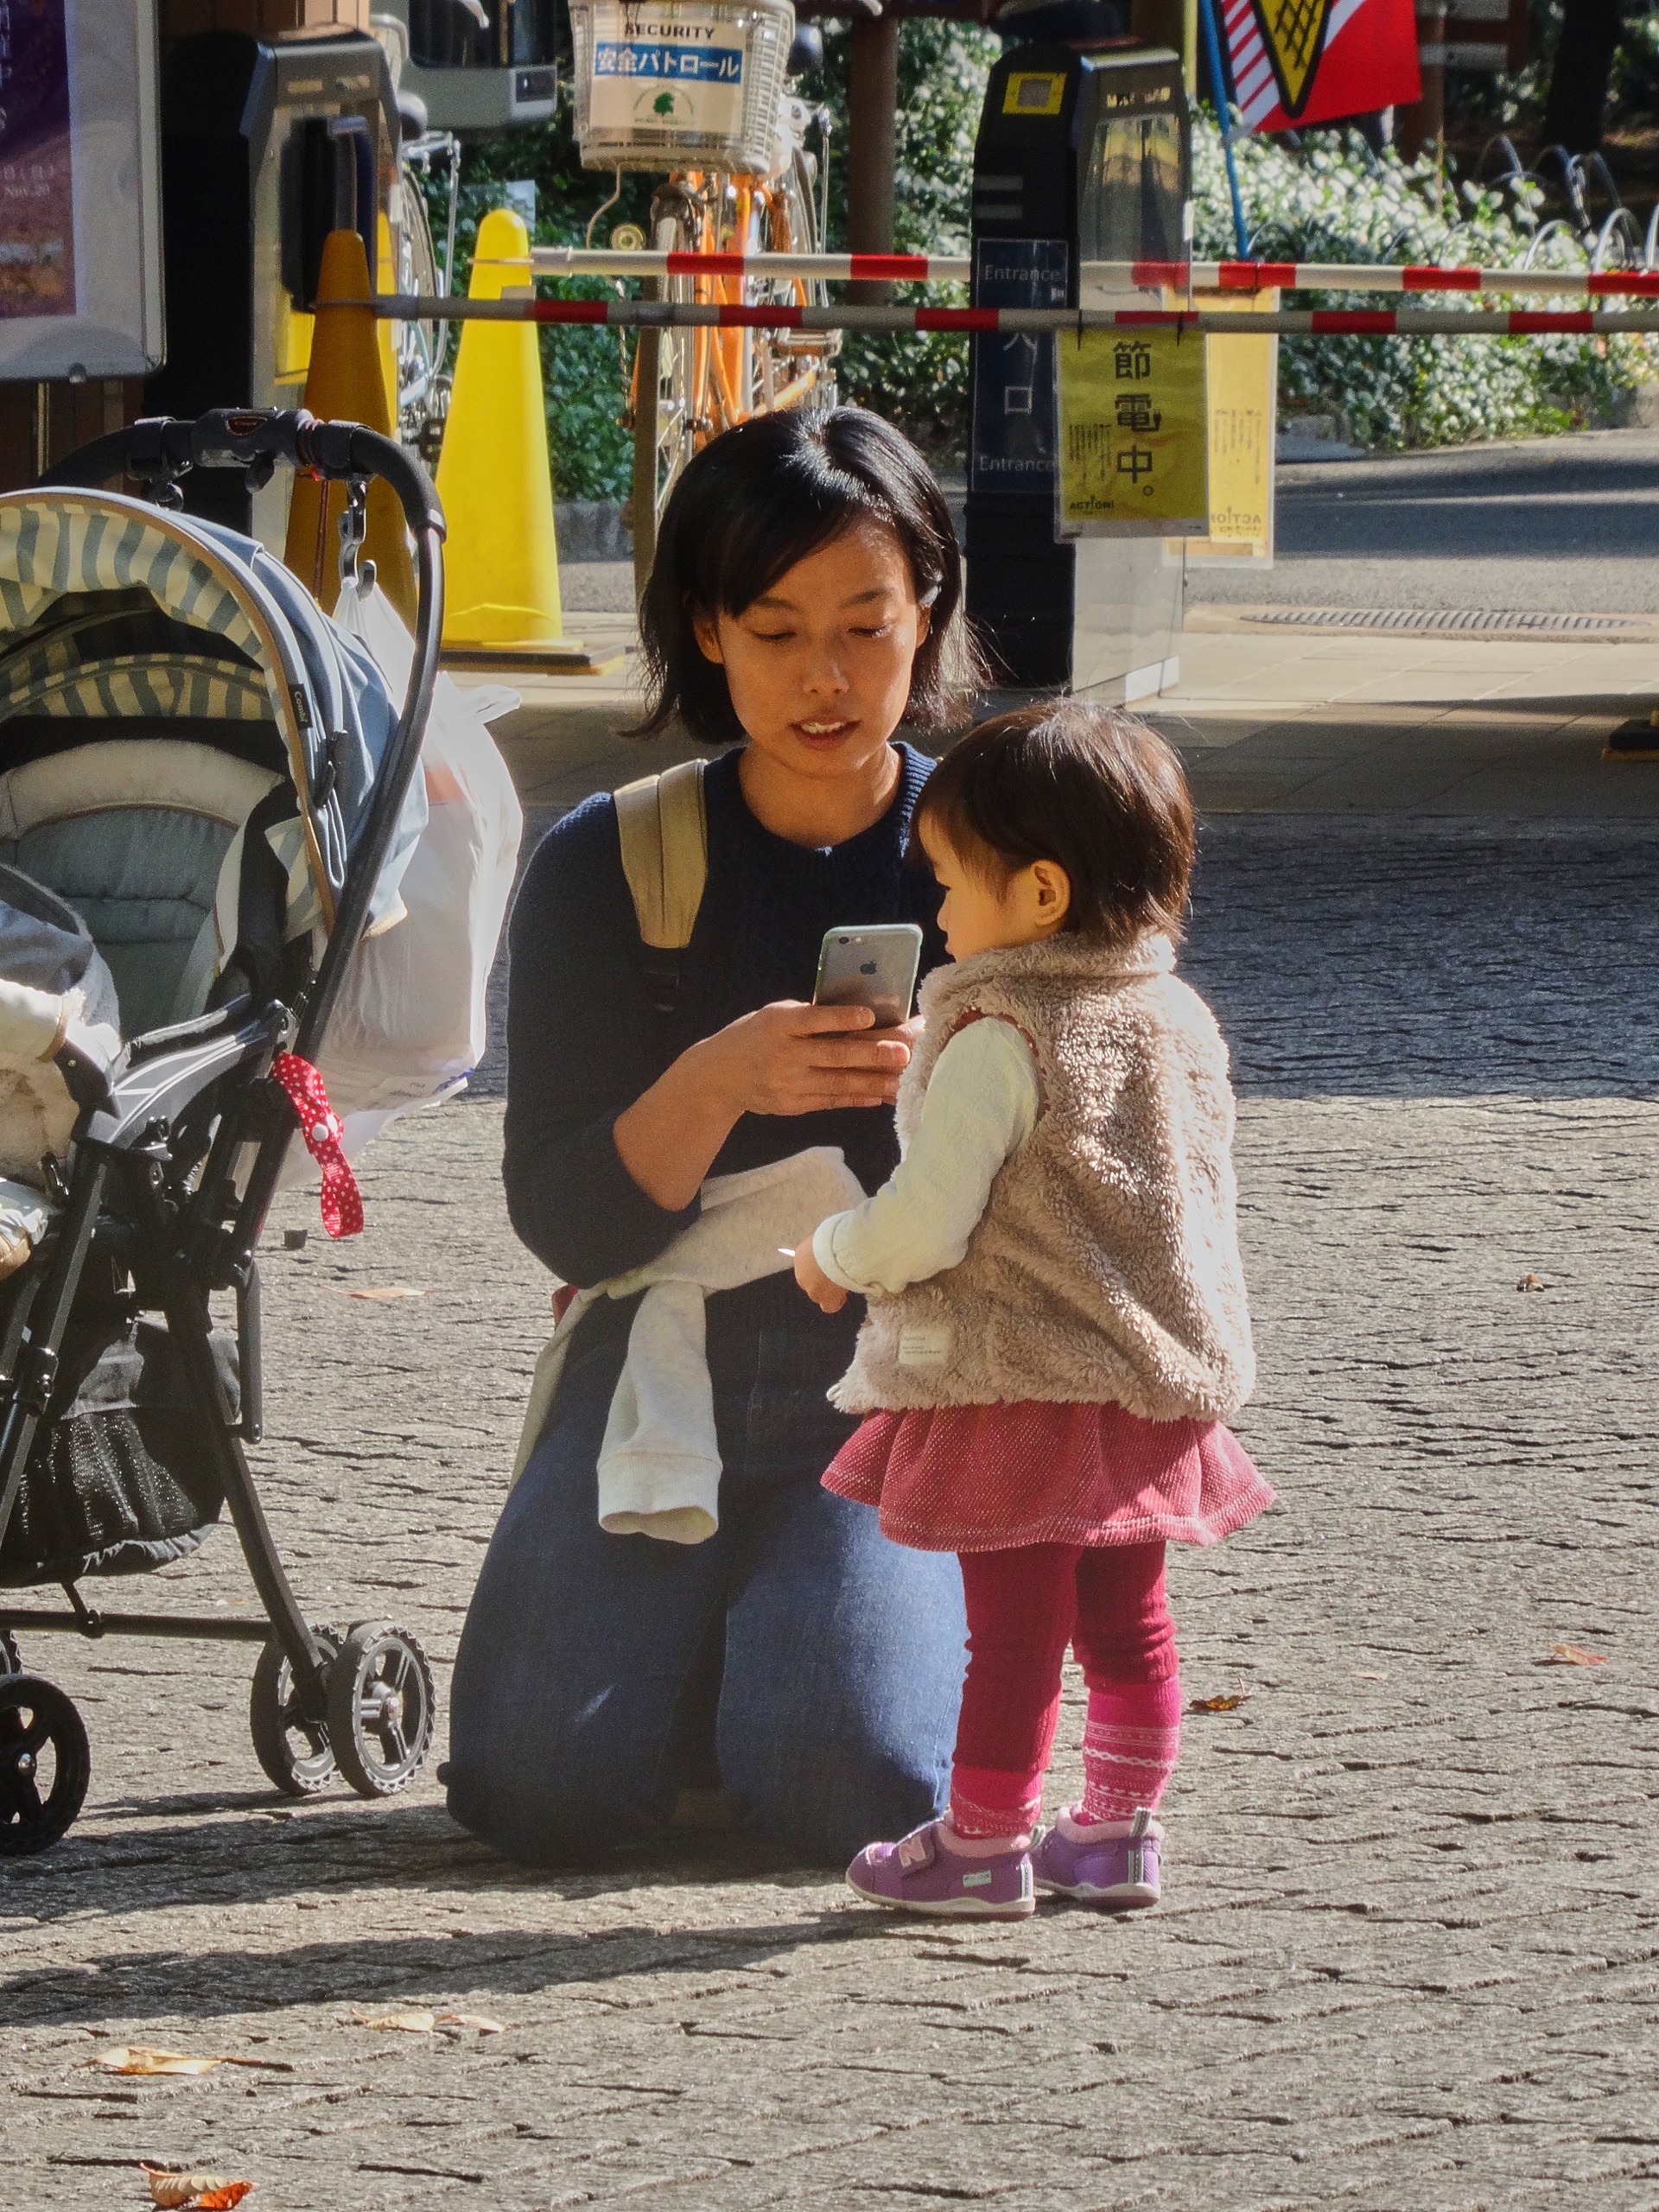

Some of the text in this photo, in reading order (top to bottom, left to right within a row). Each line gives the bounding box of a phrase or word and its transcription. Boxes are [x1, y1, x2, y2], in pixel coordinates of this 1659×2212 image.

[625, 22, 715, 40] SECURITY
[598, 46, 740, 79] 安全パトロール
[985, 264, 1060, 281] Entrance
[979, 454, 1054, 472] Entrance
